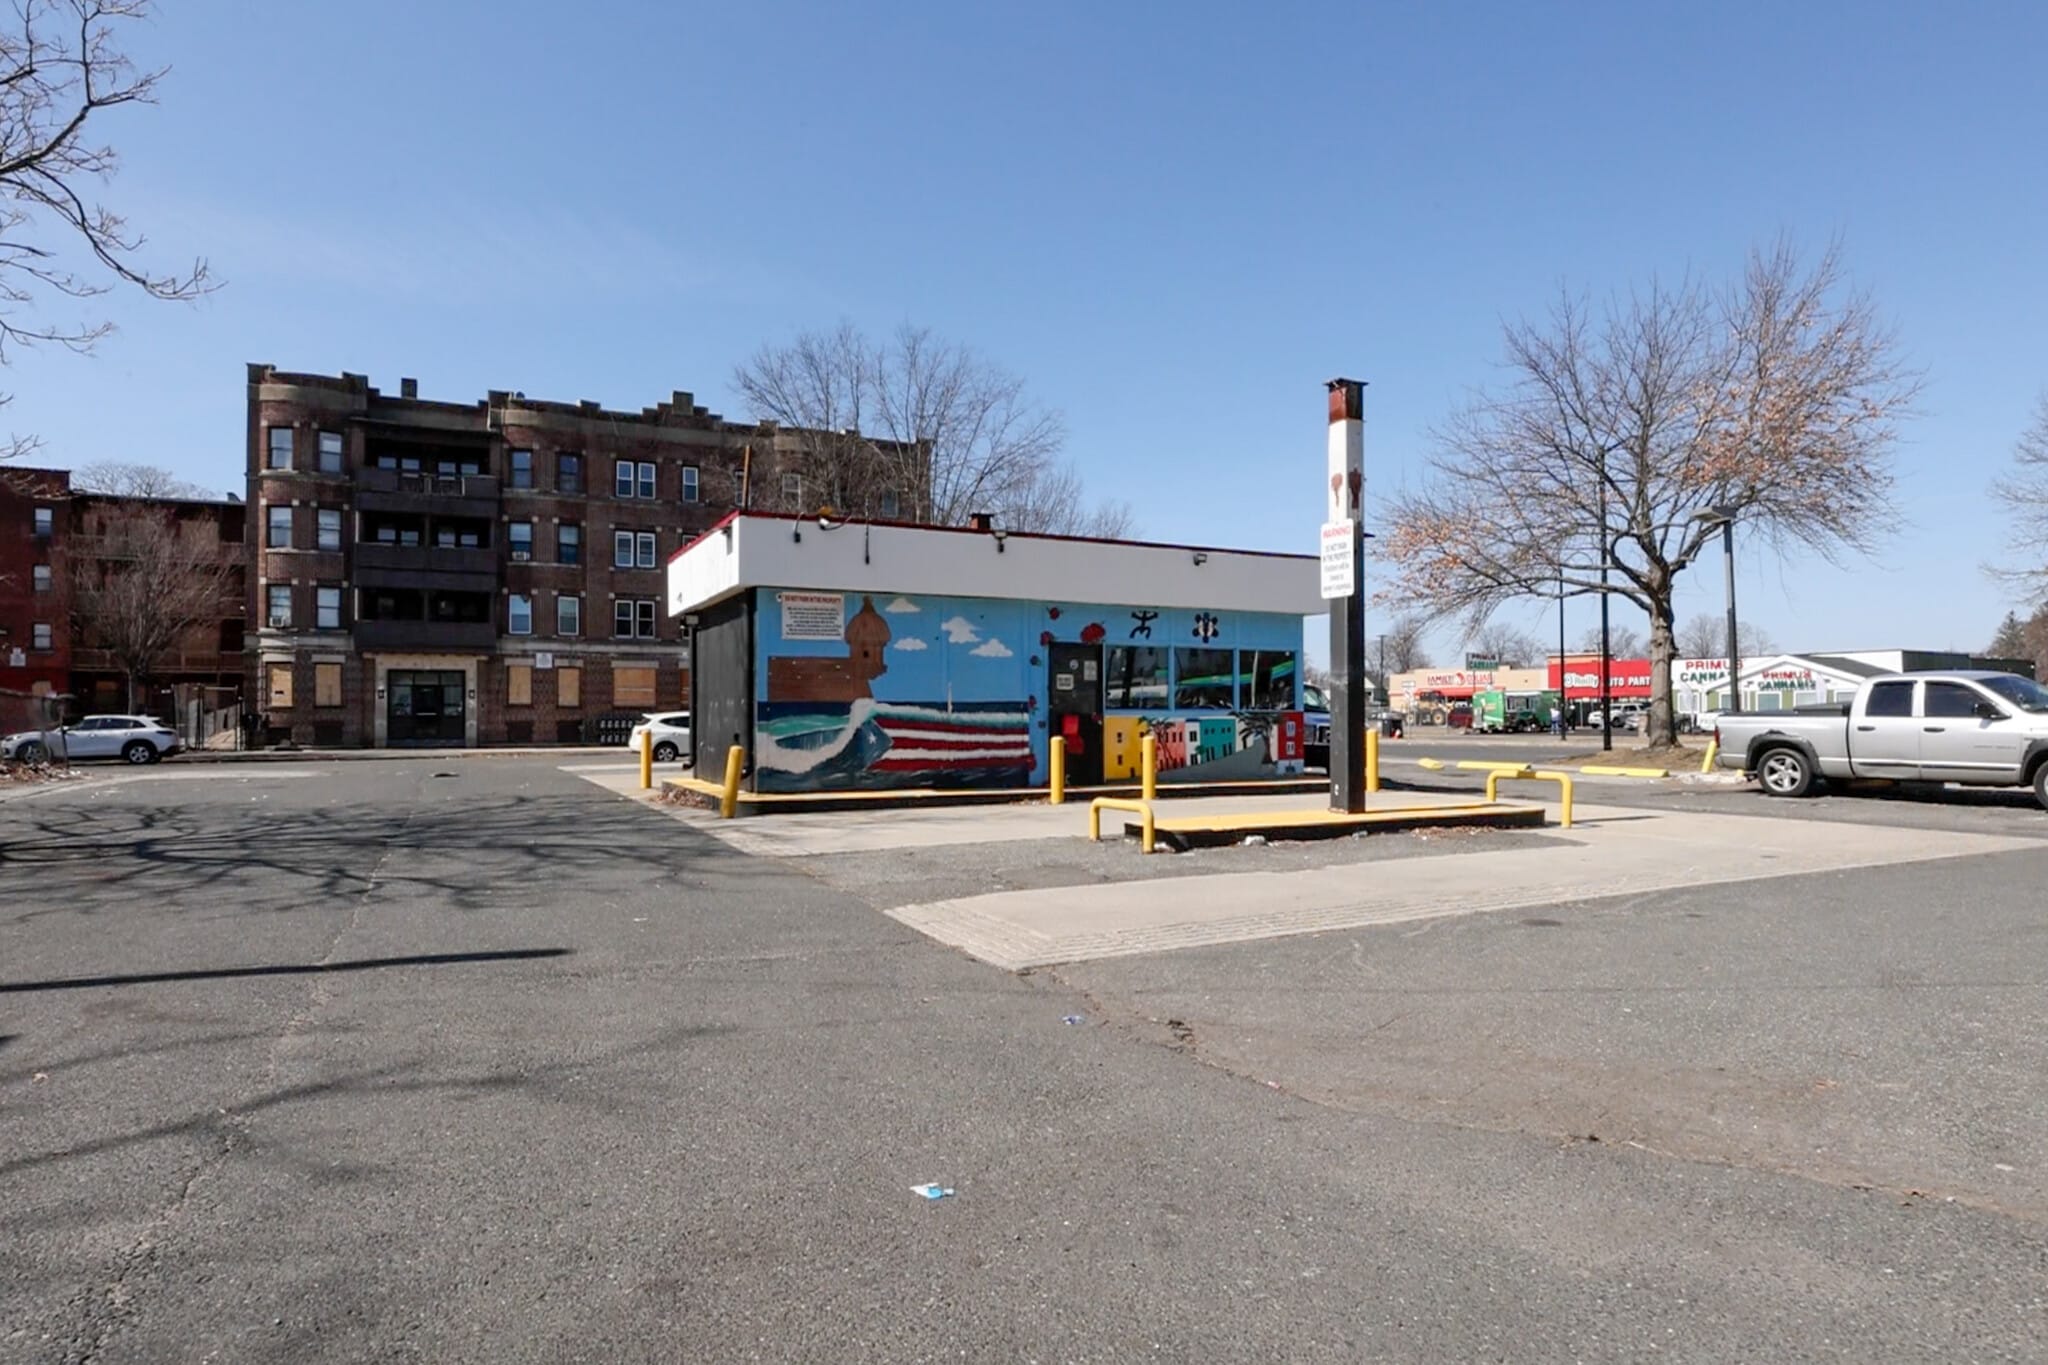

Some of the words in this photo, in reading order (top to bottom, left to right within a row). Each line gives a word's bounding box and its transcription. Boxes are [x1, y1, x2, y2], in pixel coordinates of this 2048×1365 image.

[1685, 660, 1744, 670] PRIMUS
[1680, 672, 1730, 682] CANNA
[1762, 670, 1812, 679] PRIMUS
[1628, 676, 1650, 686] PART
